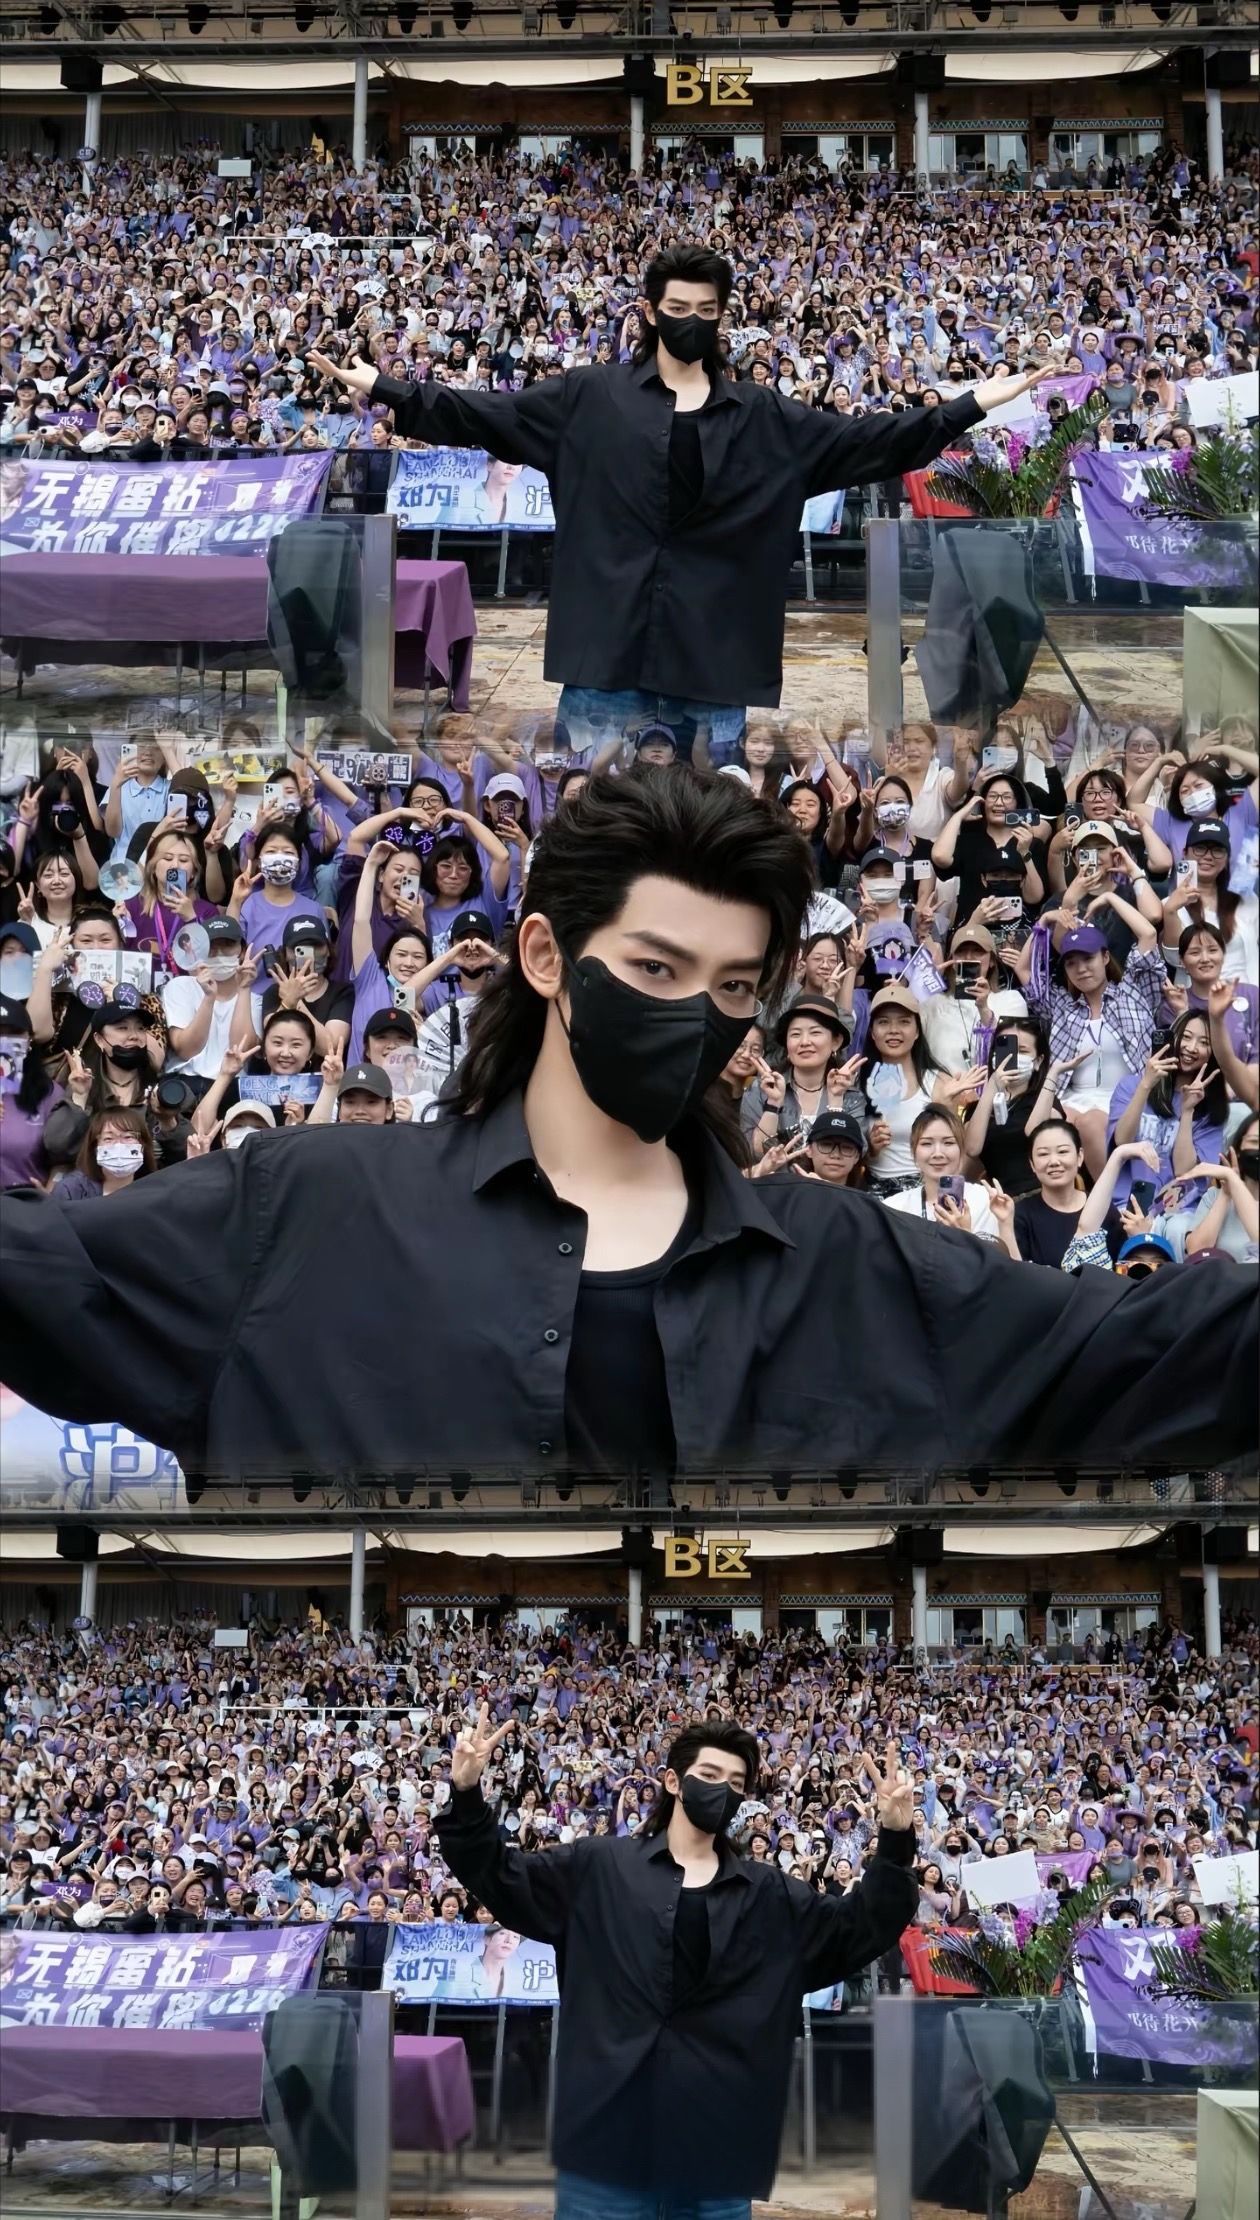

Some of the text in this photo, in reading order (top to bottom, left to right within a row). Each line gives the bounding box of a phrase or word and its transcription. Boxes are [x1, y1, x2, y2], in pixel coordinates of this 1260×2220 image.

[666, 64, 753, 106] B区
[396, 483, 451, 508] 邓为
[664, 1536, 752, 1579] B区
[393, 1957, 449, 1982] 邓为
[523, 1959, 555, 1991] 沪
